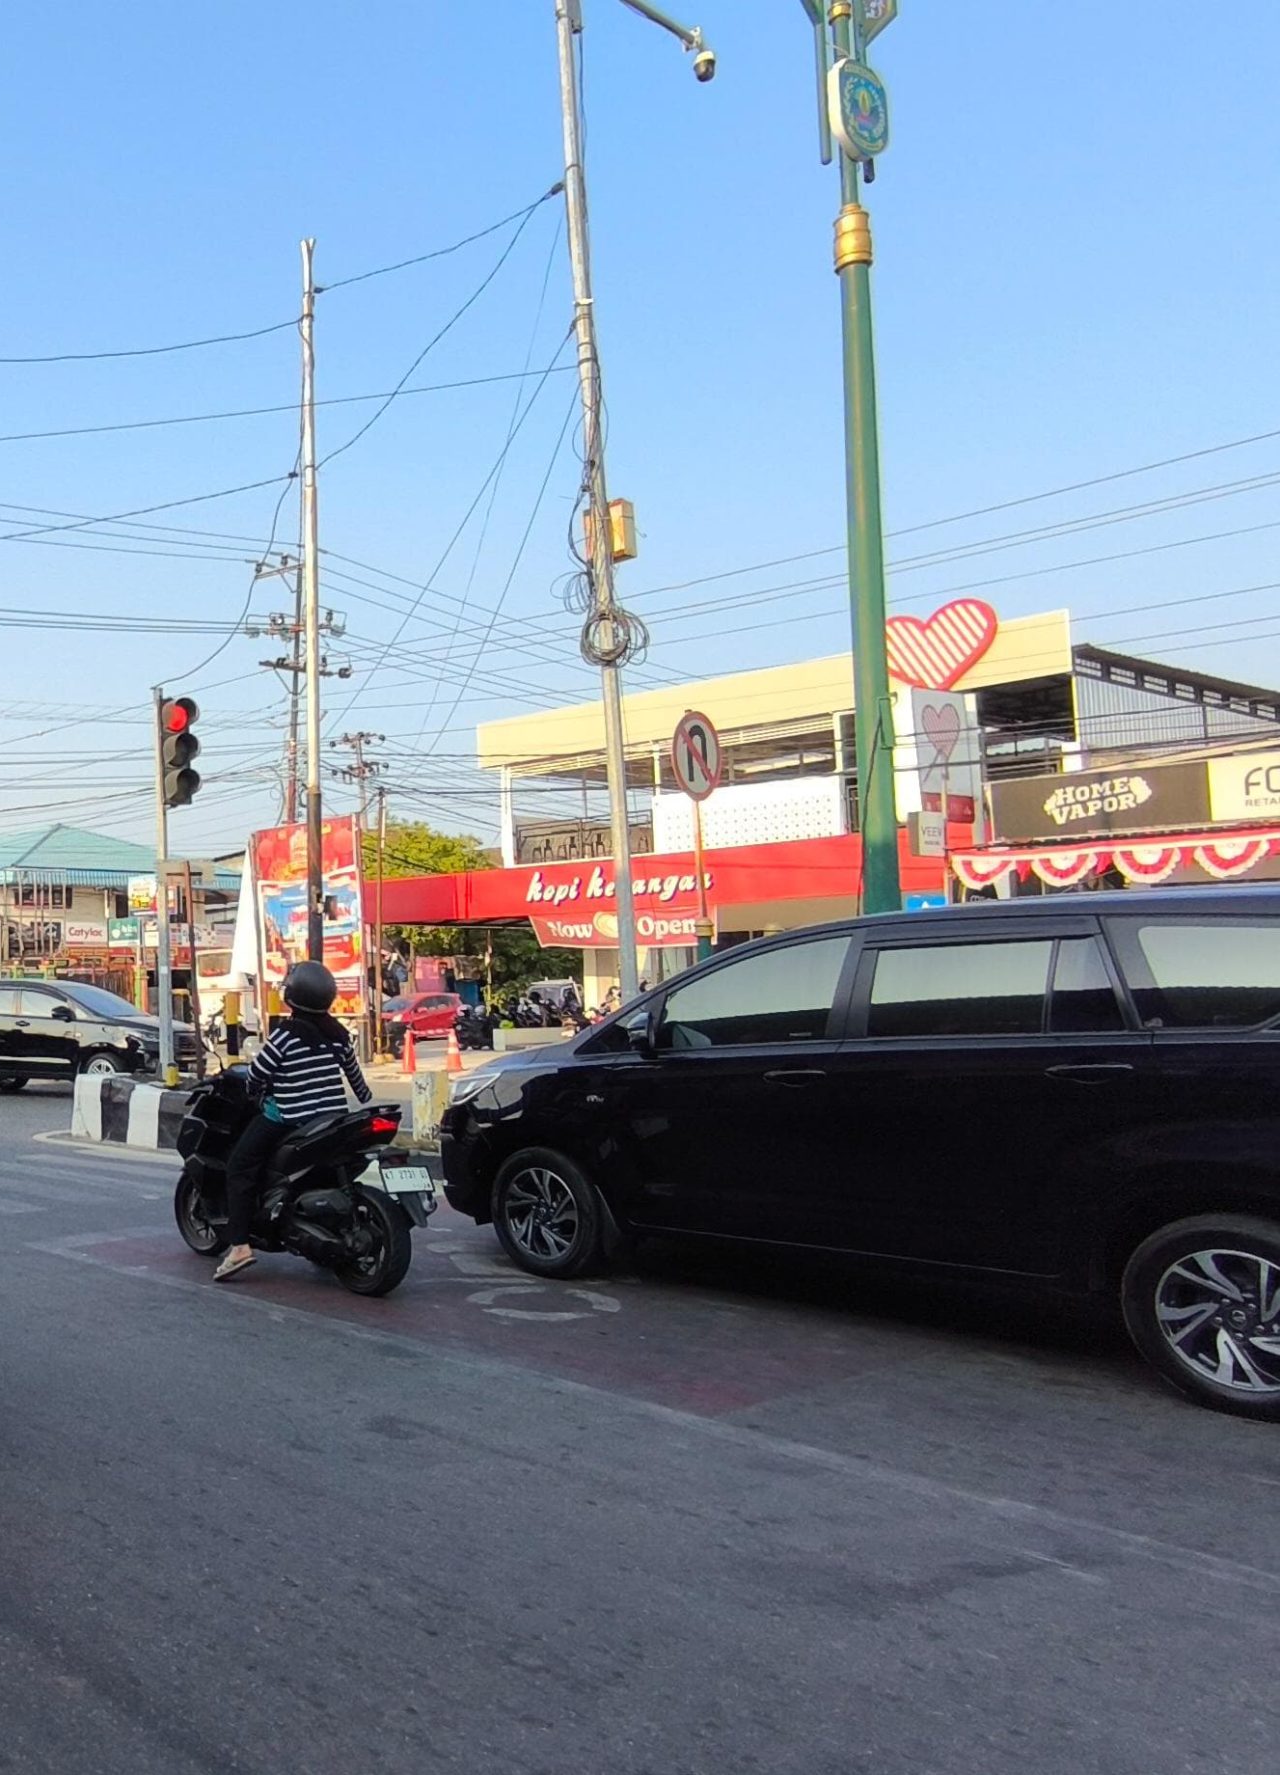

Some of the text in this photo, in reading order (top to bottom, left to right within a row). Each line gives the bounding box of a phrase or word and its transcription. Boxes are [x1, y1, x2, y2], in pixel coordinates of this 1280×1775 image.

[1054, 776, 1130, 806] HOME
[1050, 793, 1137, 825] VAPOR
[526, 866, 712, 906] kopi keanga
[548, 916, 696, 940] Now Open
